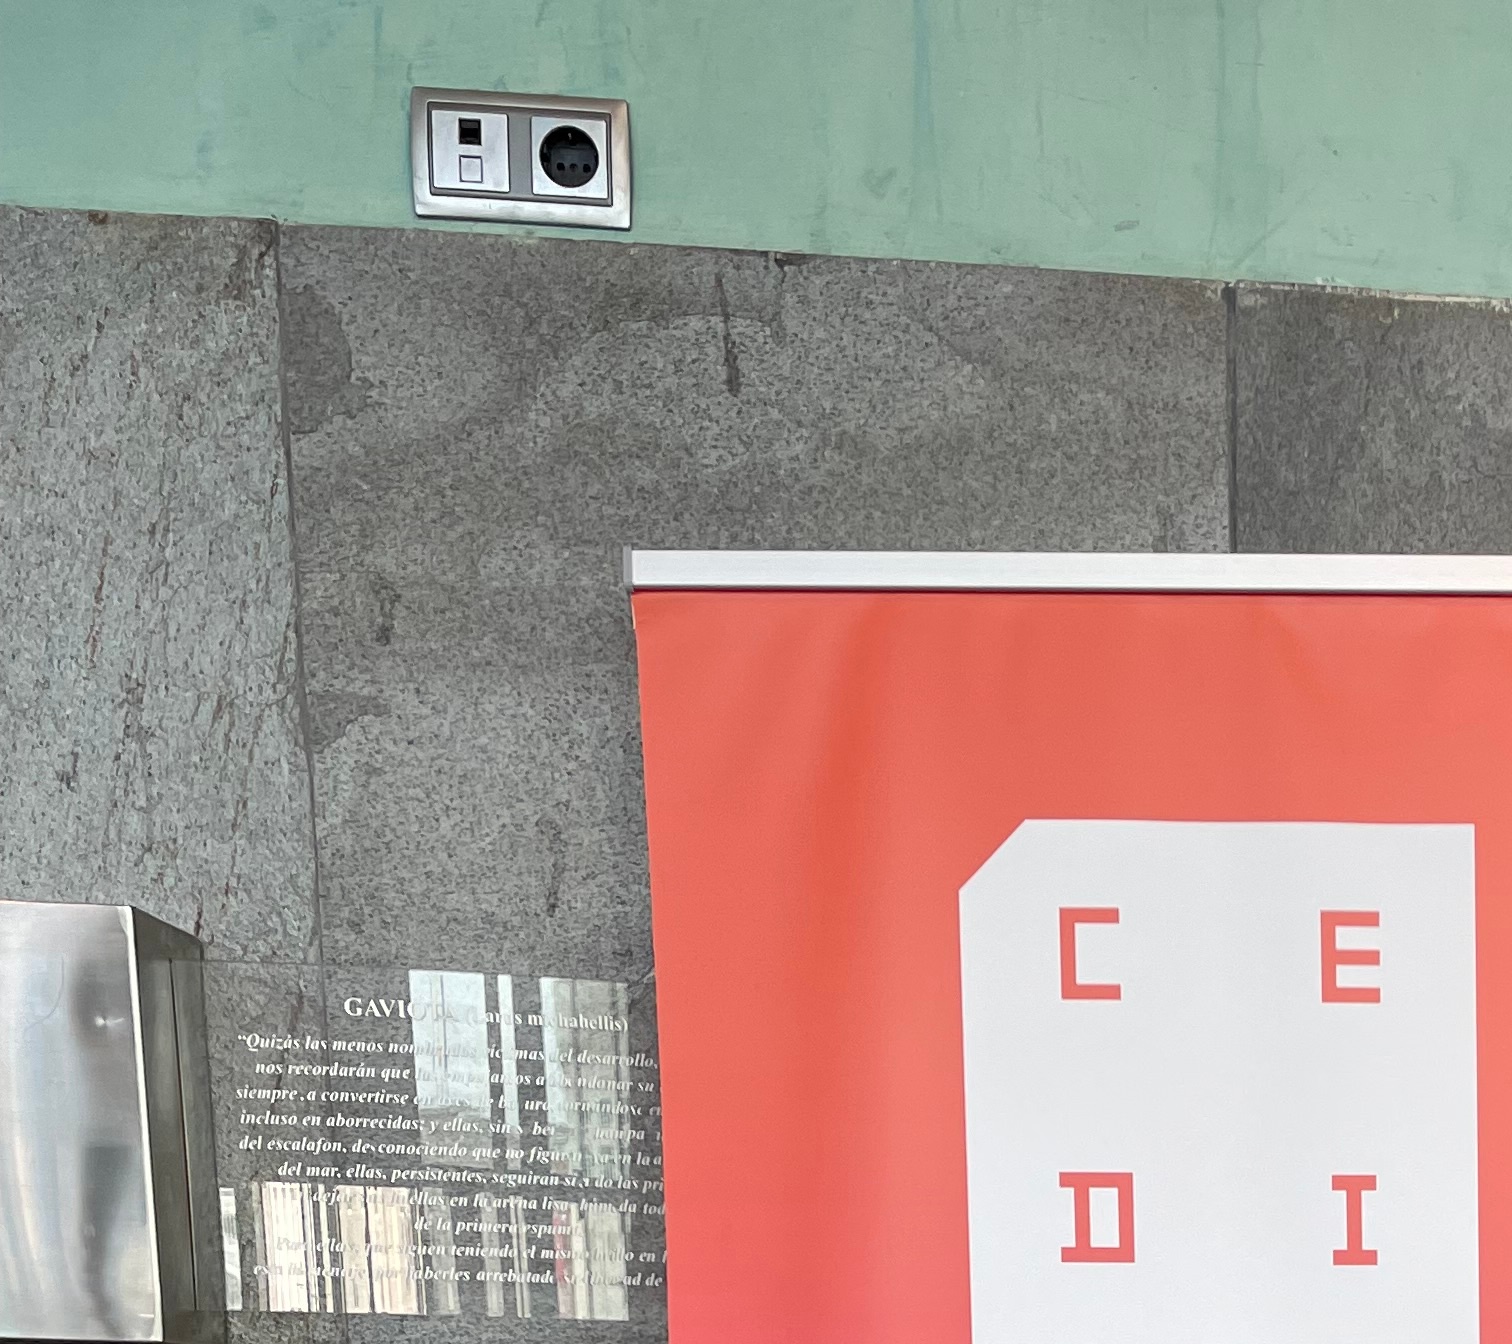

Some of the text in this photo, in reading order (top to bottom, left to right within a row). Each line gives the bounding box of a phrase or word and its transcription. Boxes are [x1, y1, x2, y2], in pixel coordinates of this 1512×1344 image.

[527, 1012, 629, 1033] mhahellis)
[305, 1035, 328, 1050] las
[332, 1040, 383, 1053] menos
[255, 1063, 283, 1075] nos
[288, 1061, 375, 1079] recordarán
[380, 1067, 411, 1082] que
[548, 1074, 634, 1092] bandonar
[321, 1088, 409, 1105] convertirse
[240, 1109, 298, 1126] incluso
[302, 1115, 321, 1127] en
[239, 1135, 263, 1150] del
[472, 1146, 501, 1161] que
[277, 1160, 302, 1176] del
[564, 1171, 613, 1188] sindo
[408, 1266, 471, 1282] aberles
